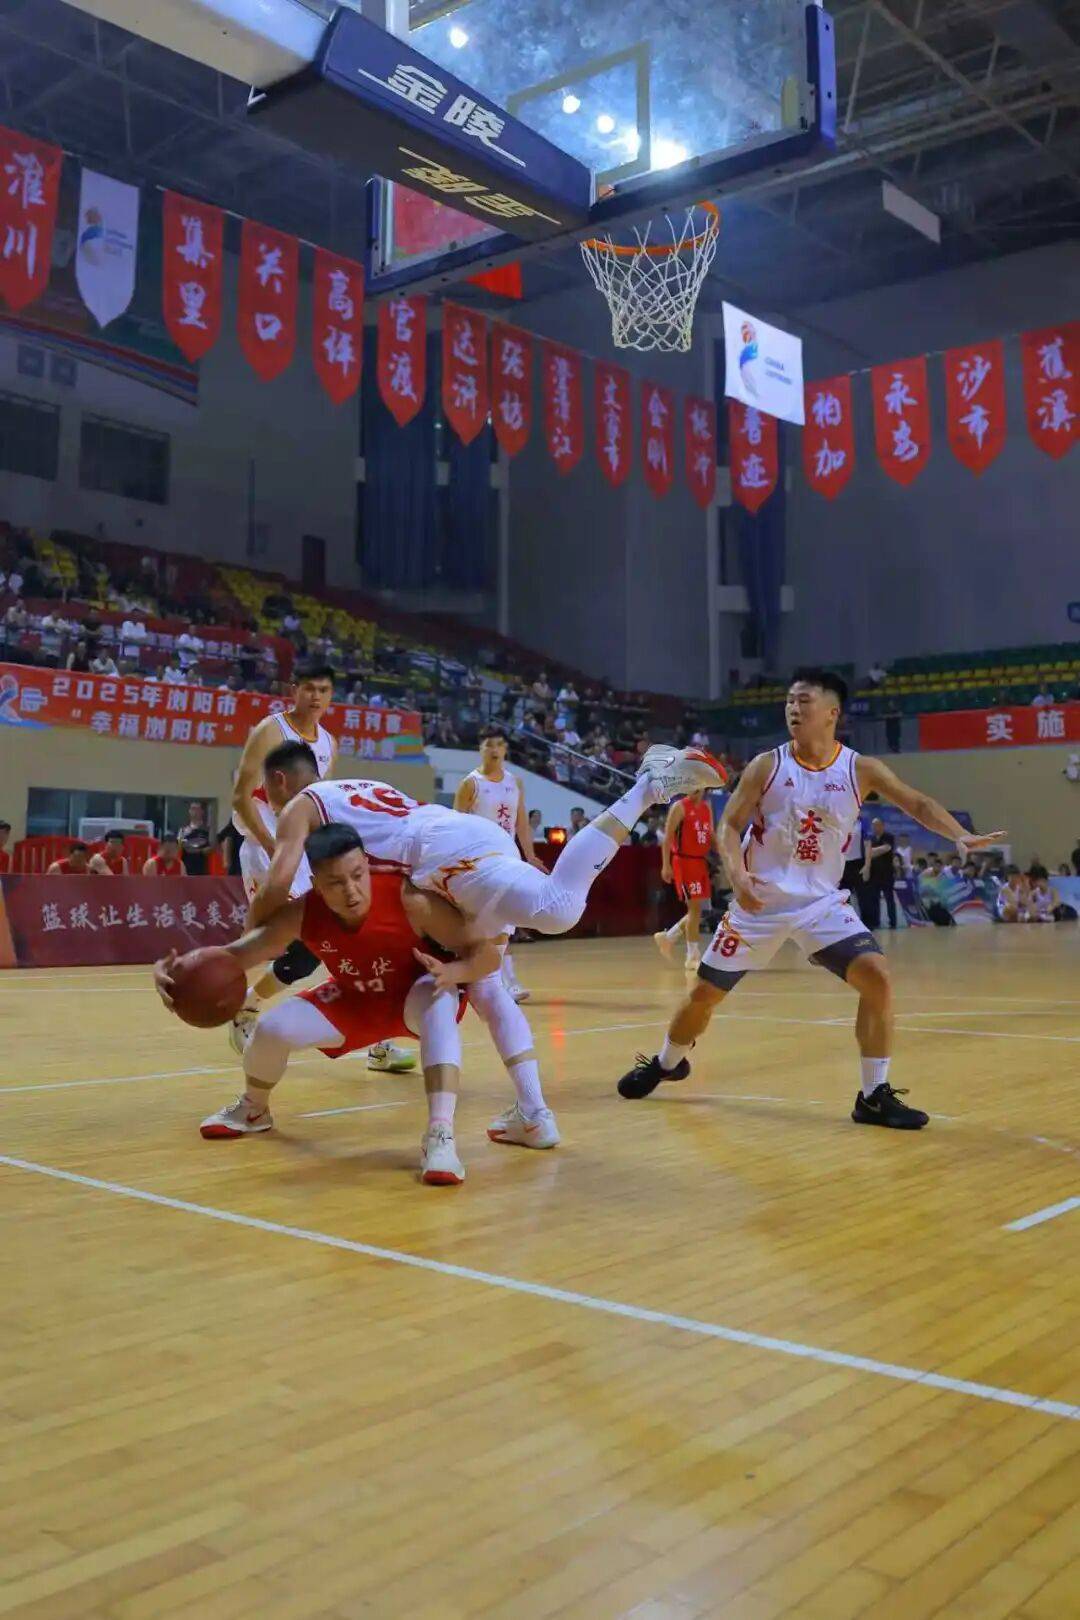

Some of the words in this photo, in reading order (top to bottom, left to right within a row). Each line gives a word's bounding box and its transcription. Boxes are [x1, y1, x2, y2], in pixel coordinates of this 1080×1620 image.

[359, 63, 526, 168] 金陵
[176, 214, 215, 330] 集里
[255, 242, 285, 342] 关口
[812, 391, 846, 477] 柏加
[884, 372, 919, 461] 永安
[956, 354, 992, 450] 沙市
[985, 709, 1066, 742] 实施
[41, 901, 248, 932] 篮球让生活更美好
[711, 929, 740, 958] 19
[338, 956, 396, 977] 龙伏
